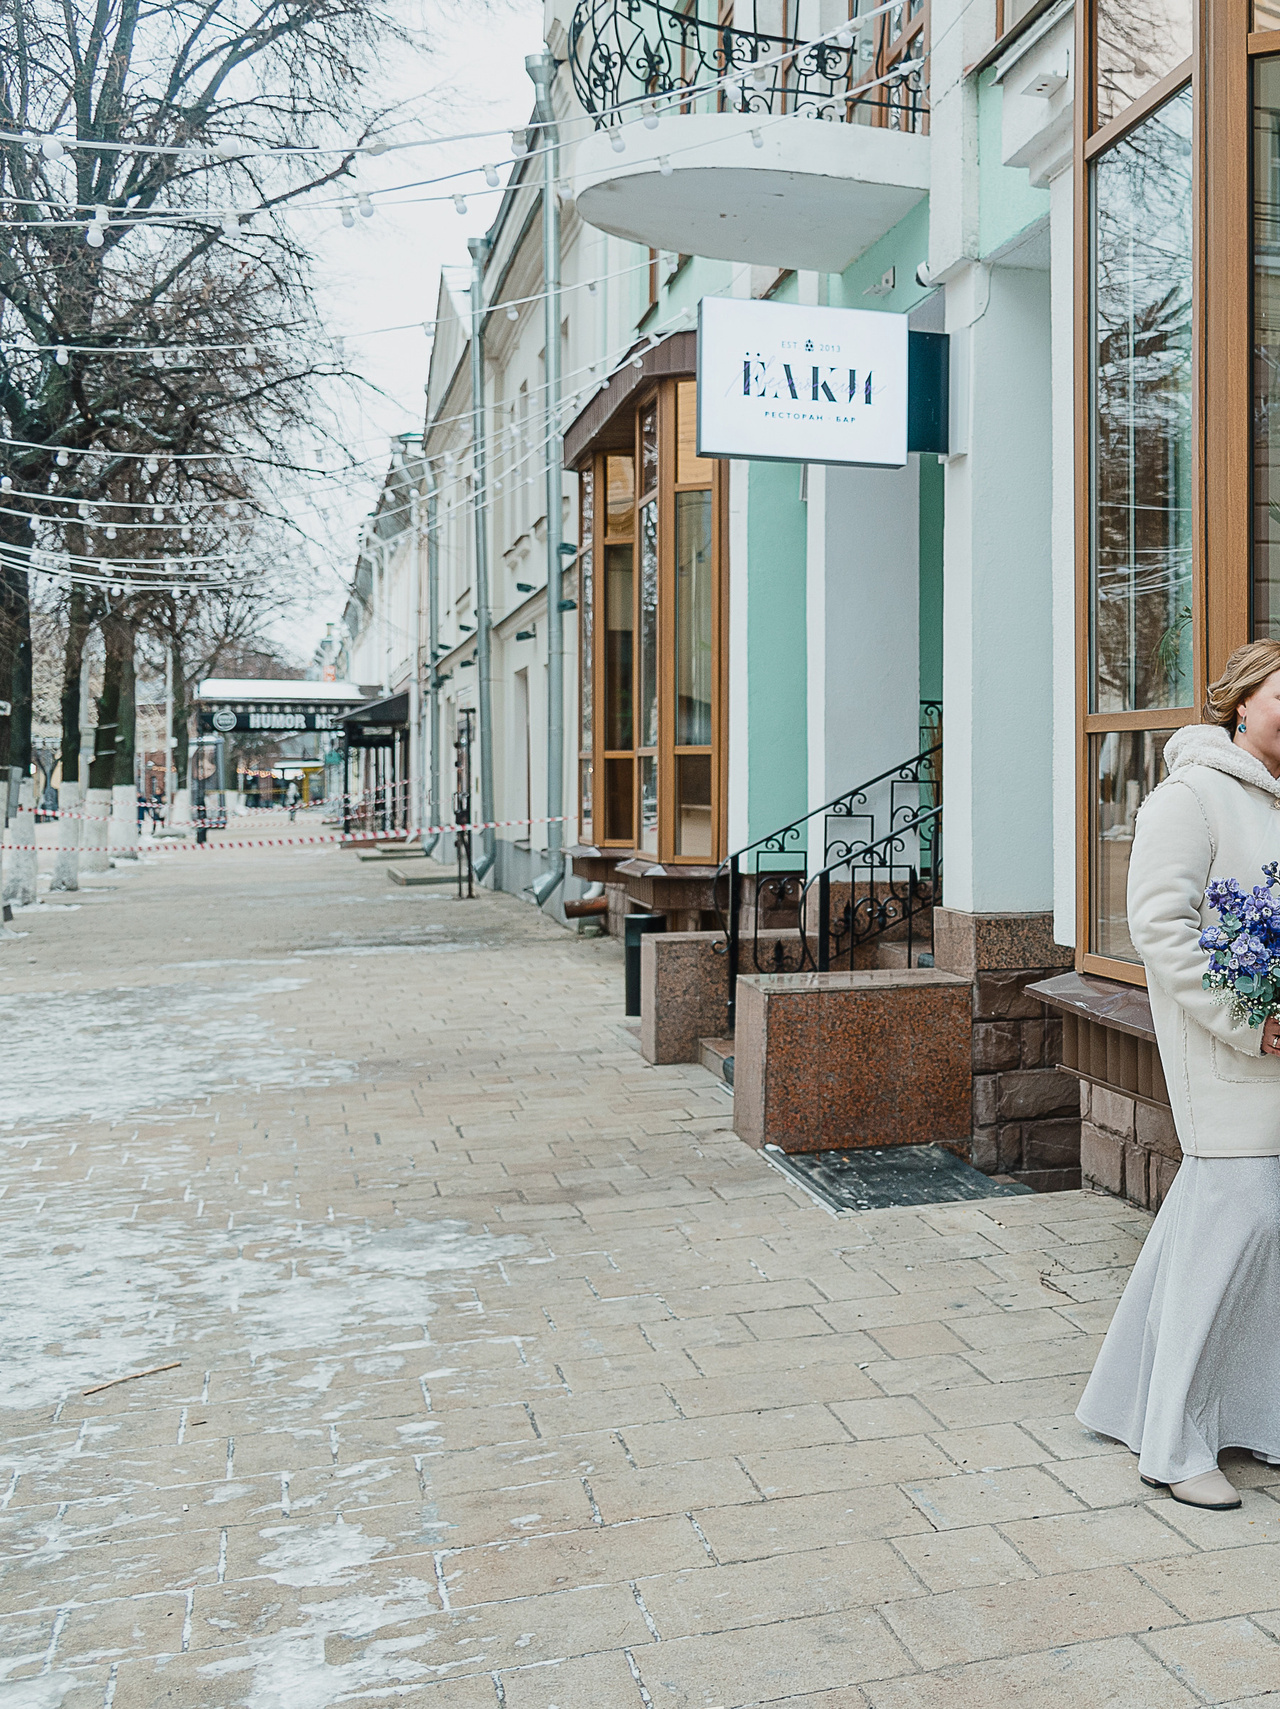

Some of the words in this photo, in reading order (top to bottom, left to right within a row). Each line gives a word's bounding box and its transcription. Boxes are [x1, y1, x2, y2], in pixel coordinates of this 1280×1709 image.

[819, 344, 841, 352] 2013
[742, 351, 874, 405] ЁЛКИ
[764, 411, 823, 421] РЕСТОРАН
[249, 713, 307, 729] HUMOR
